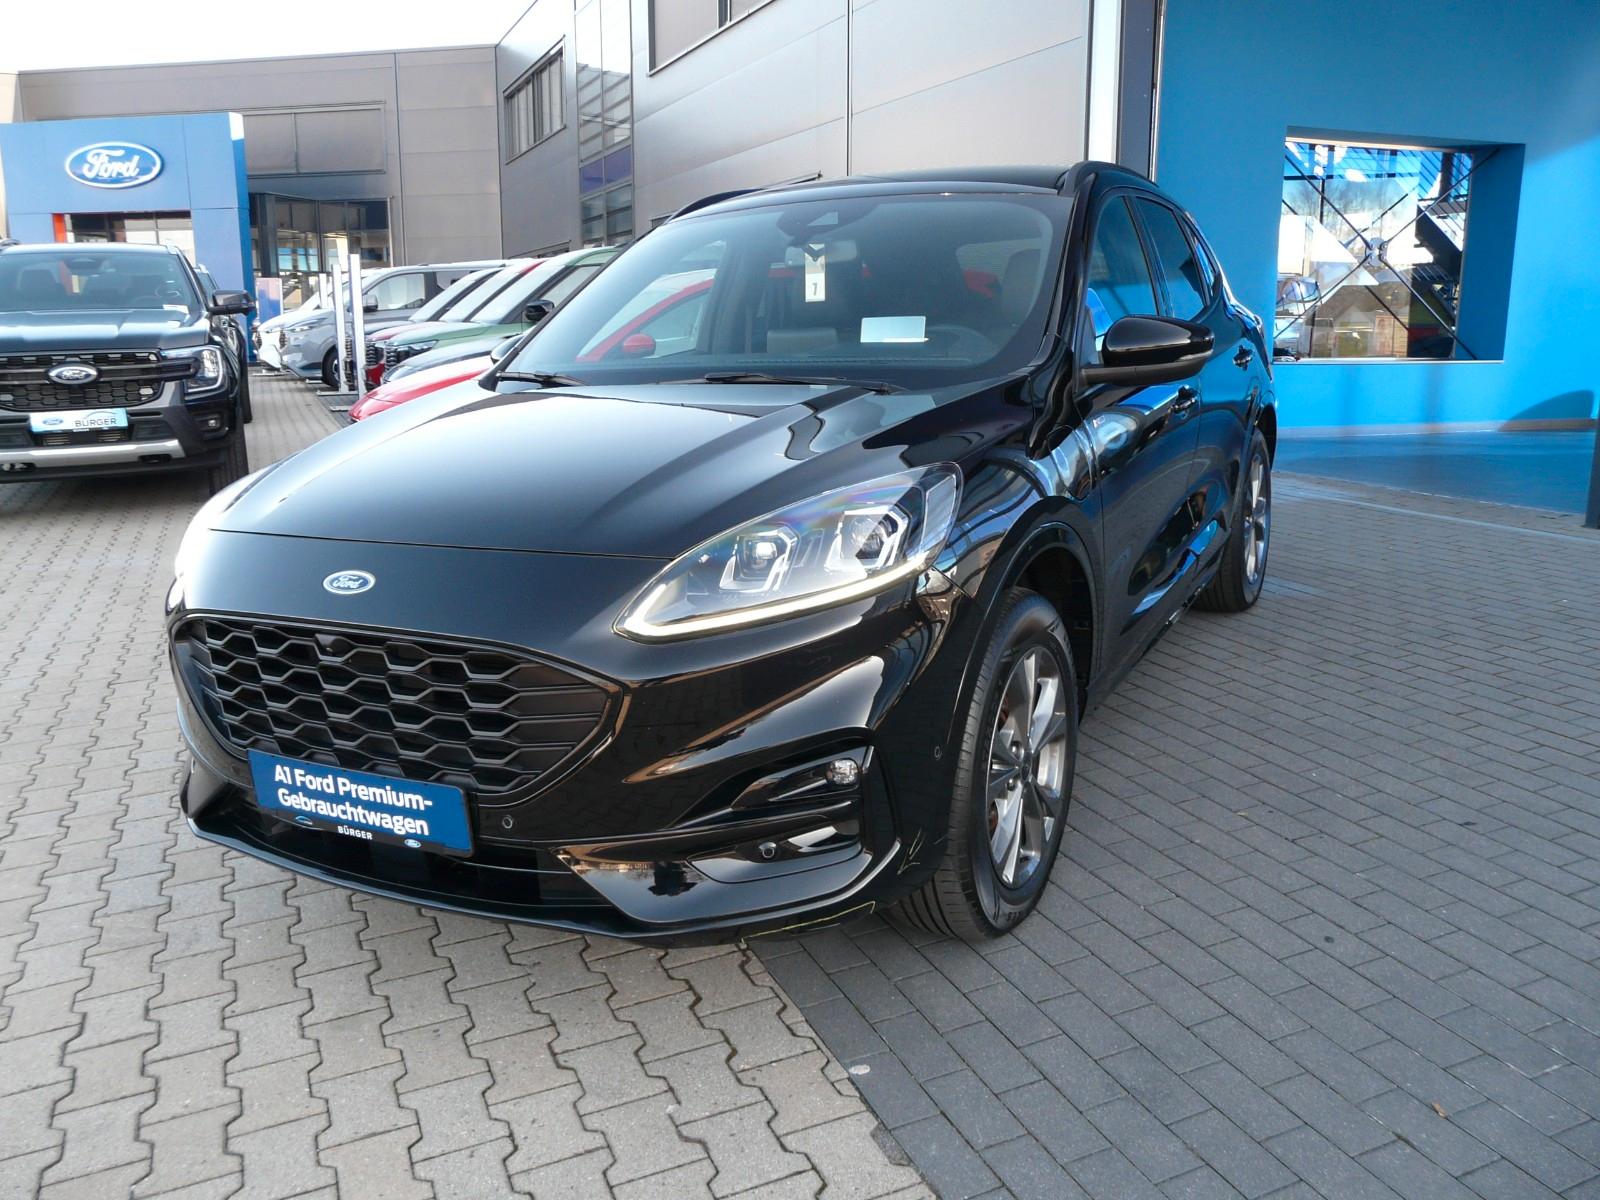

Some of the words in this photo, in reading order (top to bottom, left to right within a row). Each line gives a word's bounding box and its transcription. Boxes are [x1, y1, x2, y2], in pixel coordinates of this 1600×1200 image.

[82, 149, 140, 178] Ford
[61, 370, 87, 379] Ford
[332, 575, 363, 589] Ford
[294, 768, 335, 794] Ford
[336, 777, 432, 811] Premium-
[277, 788, 430, 836] Gebrauchtwagen
[337, 825, 373, 840] BÜRGER
